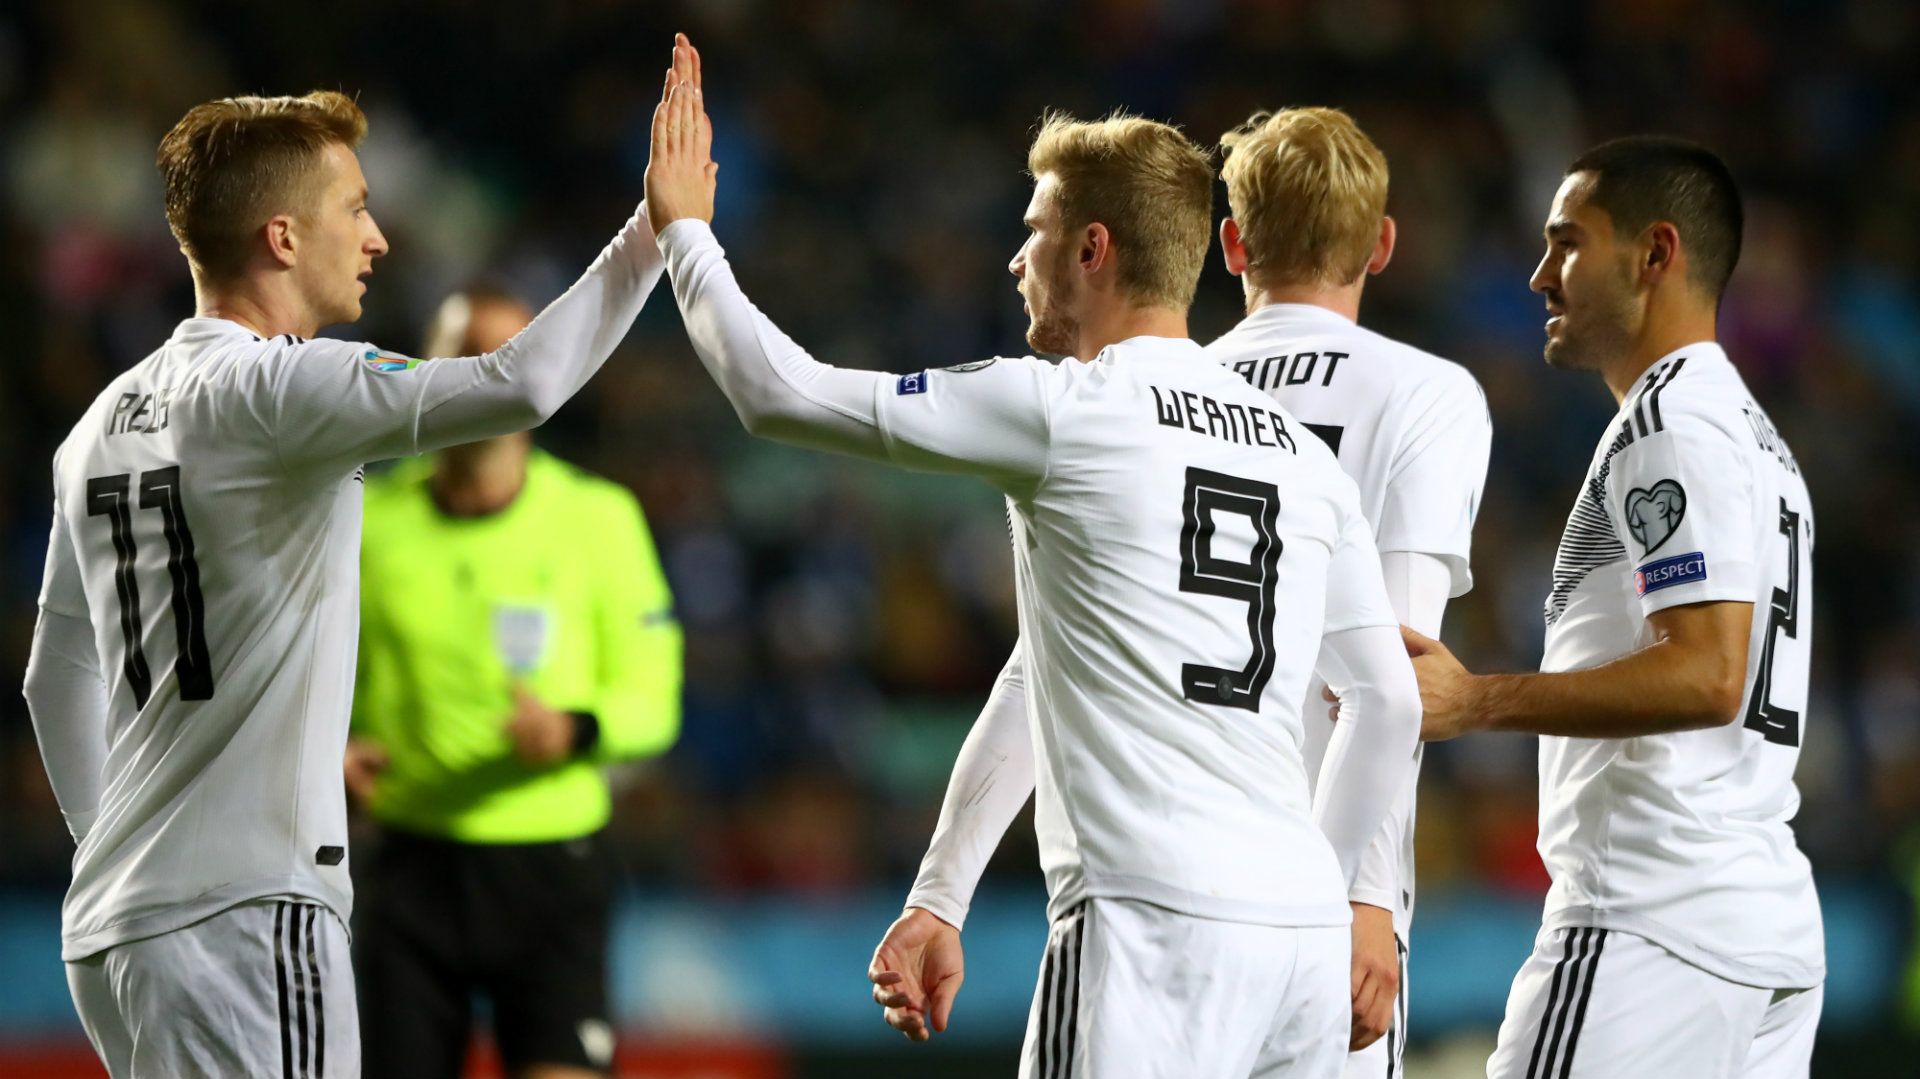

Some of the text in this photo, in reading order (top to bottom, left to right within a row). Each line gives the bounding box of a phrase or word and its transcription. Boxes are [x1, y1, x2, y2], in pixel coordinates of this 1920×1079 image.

[1150, 385, 1297, 455] WERNER
[1221, 351, 1350, 391] ANDT
[87, 465, 214, 712] 11
[1178, 466, 1283, 713] 9
[1646, 559, 1704, 584] RESPECT
[1743, 496, 1811, 747] 2
